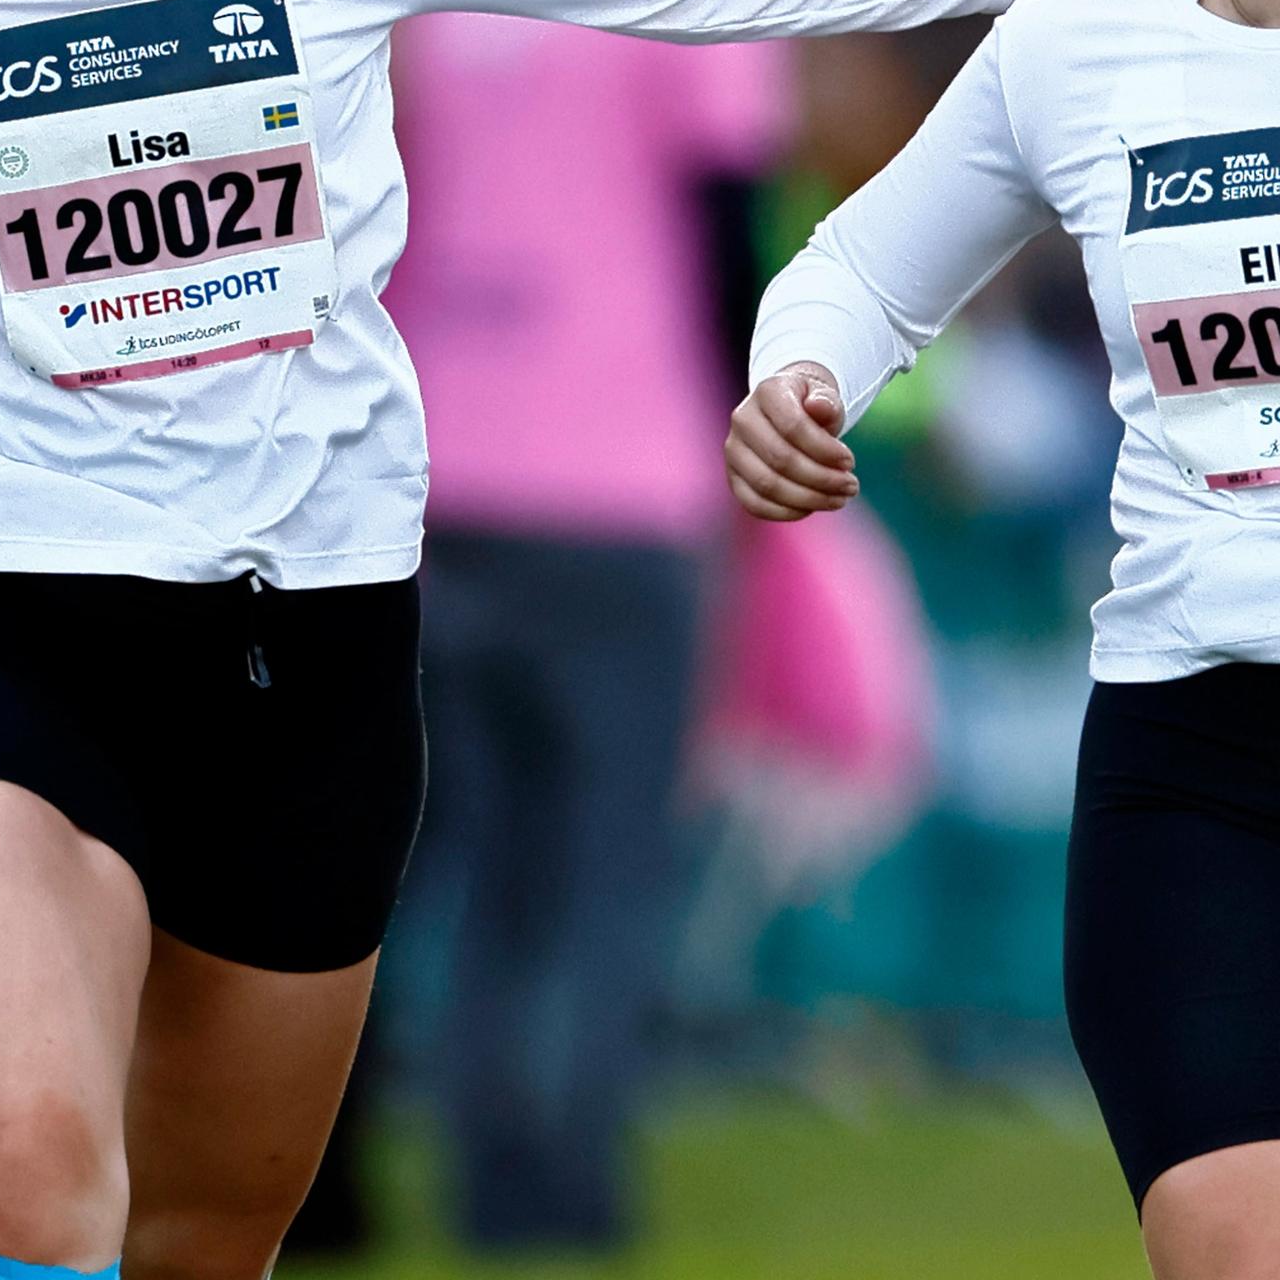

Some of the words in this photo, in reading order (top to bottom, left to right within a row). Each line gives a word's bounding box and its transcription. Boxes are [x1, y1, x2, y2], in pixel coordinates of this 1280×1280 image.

[67, 35, 115, 55] TATA
[68, 40, 180, 71] CONSULTANCY
[208, 39, 279, 63] TATA
[71, 64, 143, 88] SERVICES
[107, 130, 190, 168] Lisa
[1223, 153, 1269, 169] TATA
[1144, 168, 1214, 211] tcs
[5, 162, 302, 281] 120027
[90, 267, 281, 325] INTERSPORT
[159, 321, 241, 346] LIDINGÖLOPPET
